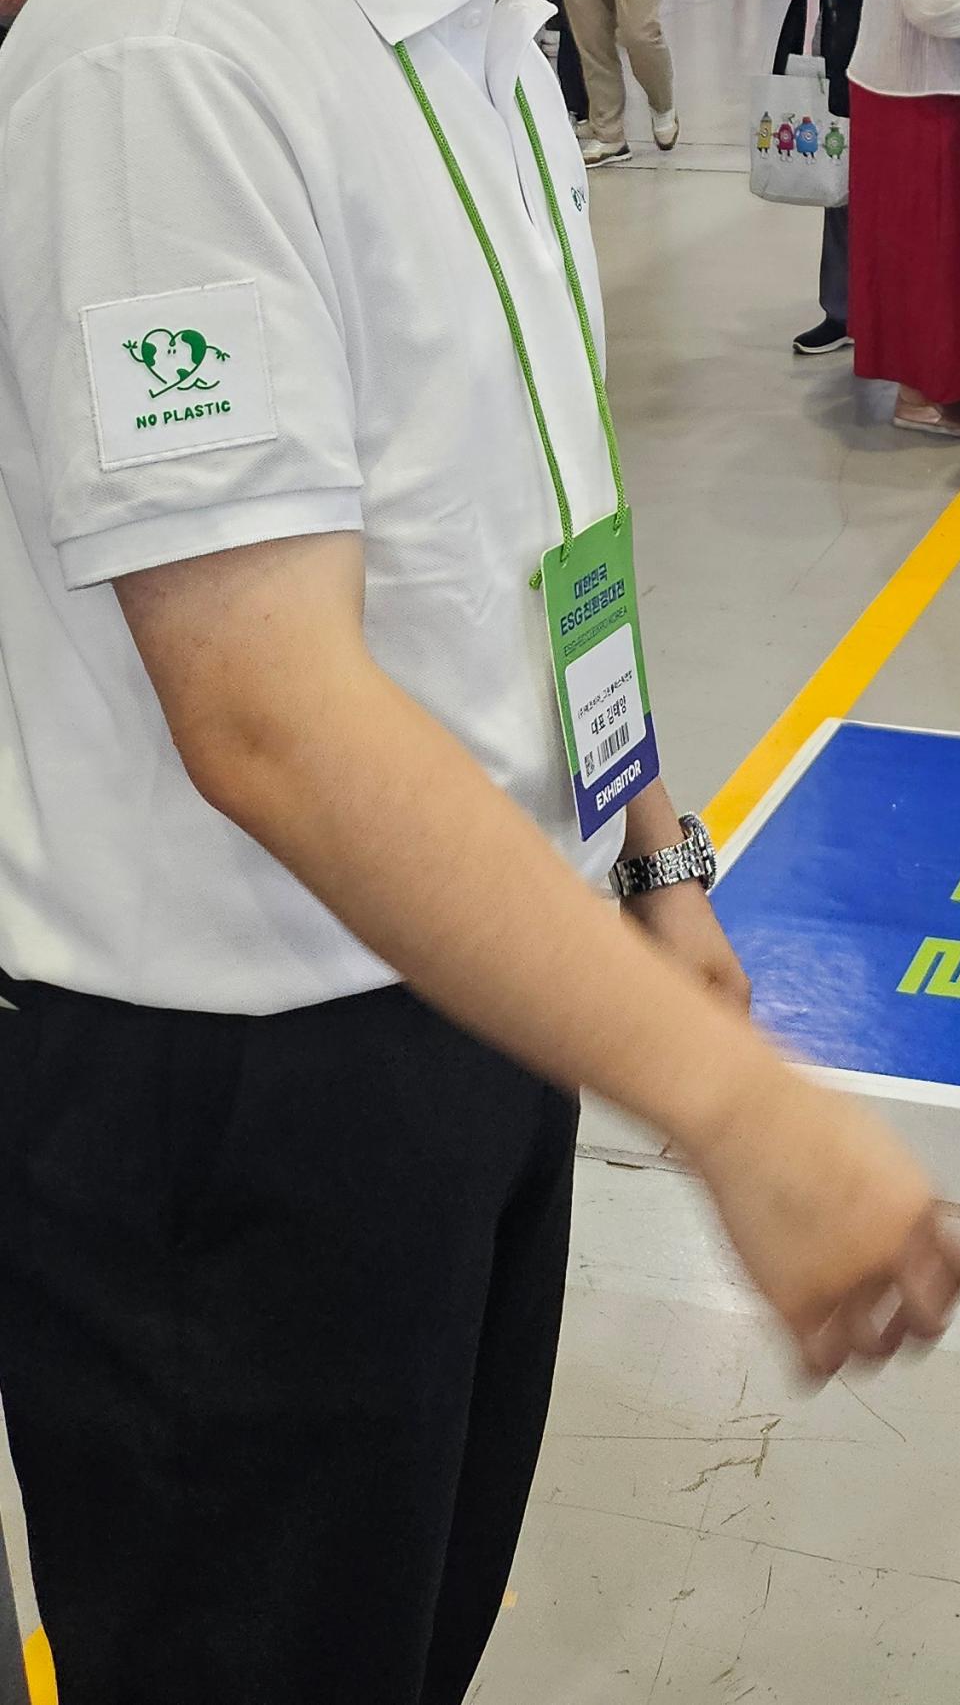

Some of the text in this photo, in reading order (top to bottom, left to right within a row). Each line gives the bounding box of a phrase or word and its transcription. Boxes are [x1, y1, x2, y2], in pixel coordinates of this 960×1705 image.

[136, 400, 231, 429] NO PLASTIC
[595, 759, 642, 812] EXHIBITOR
